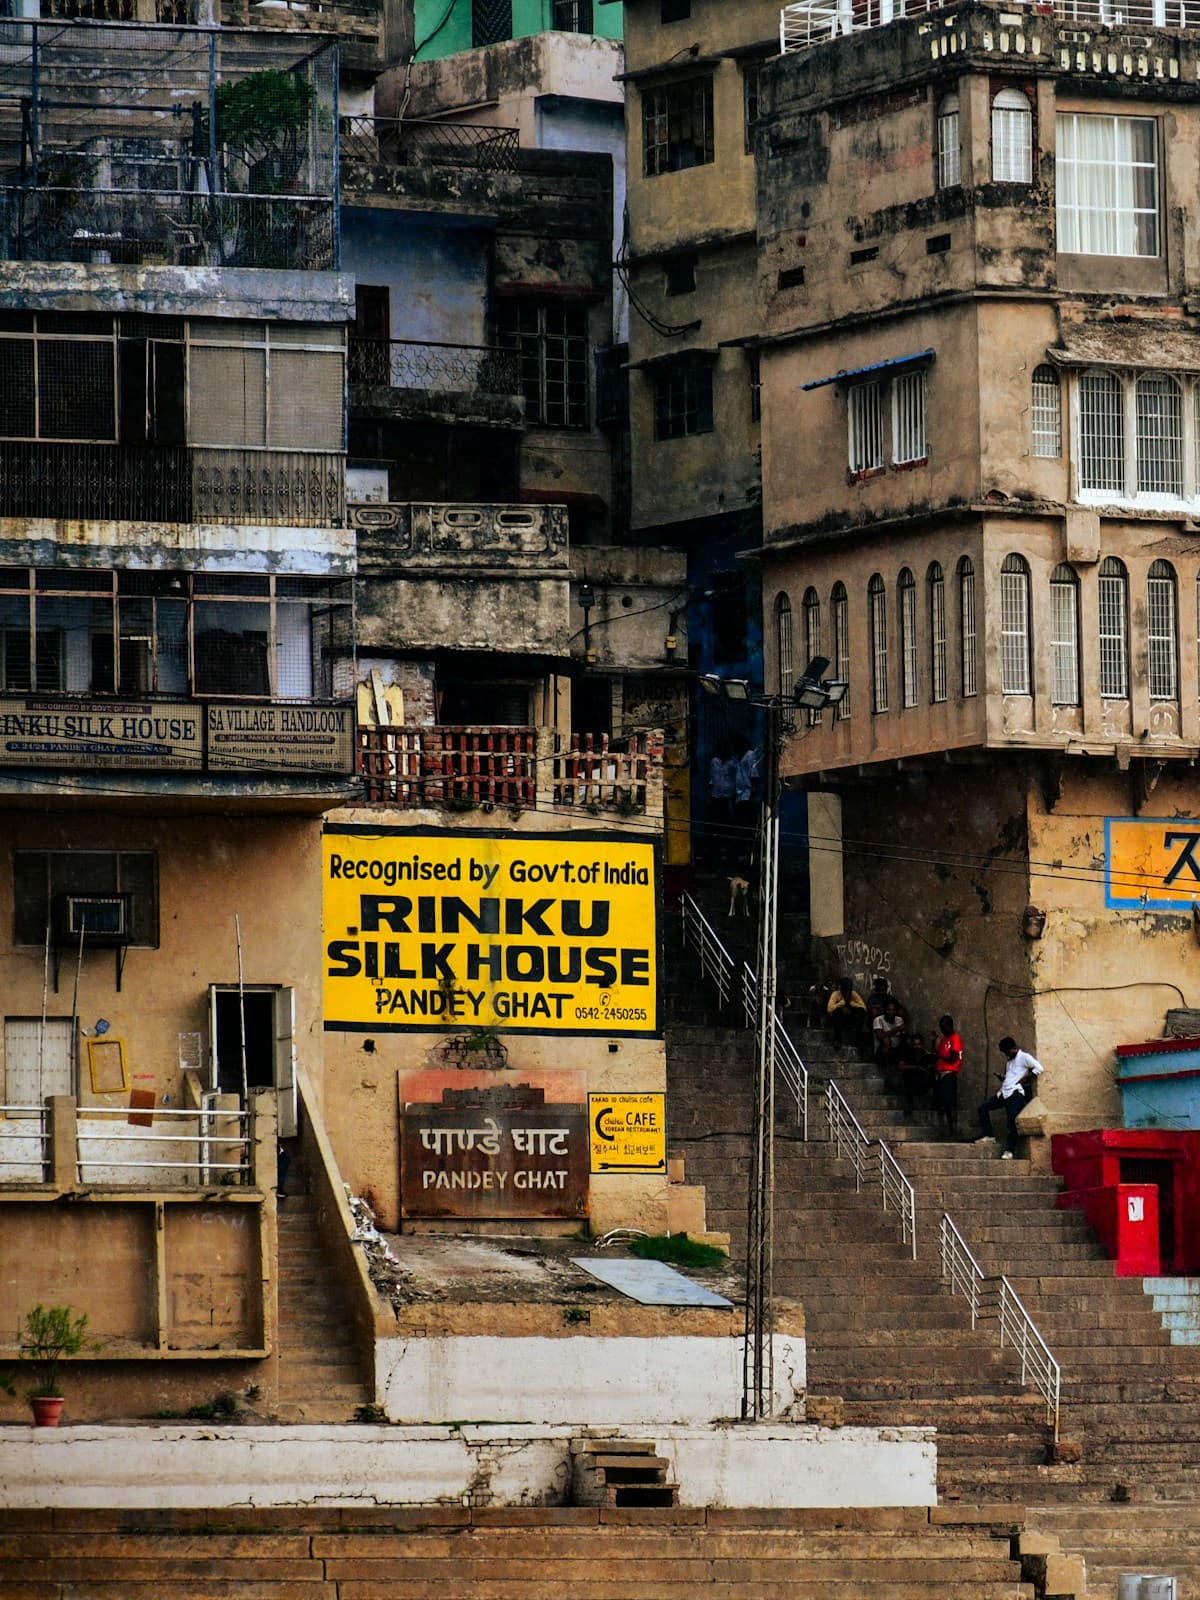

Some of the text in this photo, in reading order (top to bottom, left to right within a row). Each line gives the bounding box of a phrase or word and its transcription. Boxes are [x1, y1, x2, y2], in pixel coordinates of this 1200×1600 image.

[0, 714, 196, 741] INKU SILK HOUSE
[209, 709, 346, 733] SA VILLAGE HANDLOOM
[330, 854, 460, 886] Recognised
[469, 857, 499, 889] by
[603, 861, 649, 886] India
[360, 894, 610, 937] RINKU
[327, 940, 649, 986] SILK HOUSE
[375, 988, 574, 1019] PANDEY GHAT
[574, 1007, 648, 1021] 0542-2450255
[626, 1112, 656, 1126] CAFE
[418, 1117, 570, 1156] पाण्डे घाट
[422, 1170, 569, 1190] PANDEY GHAT
